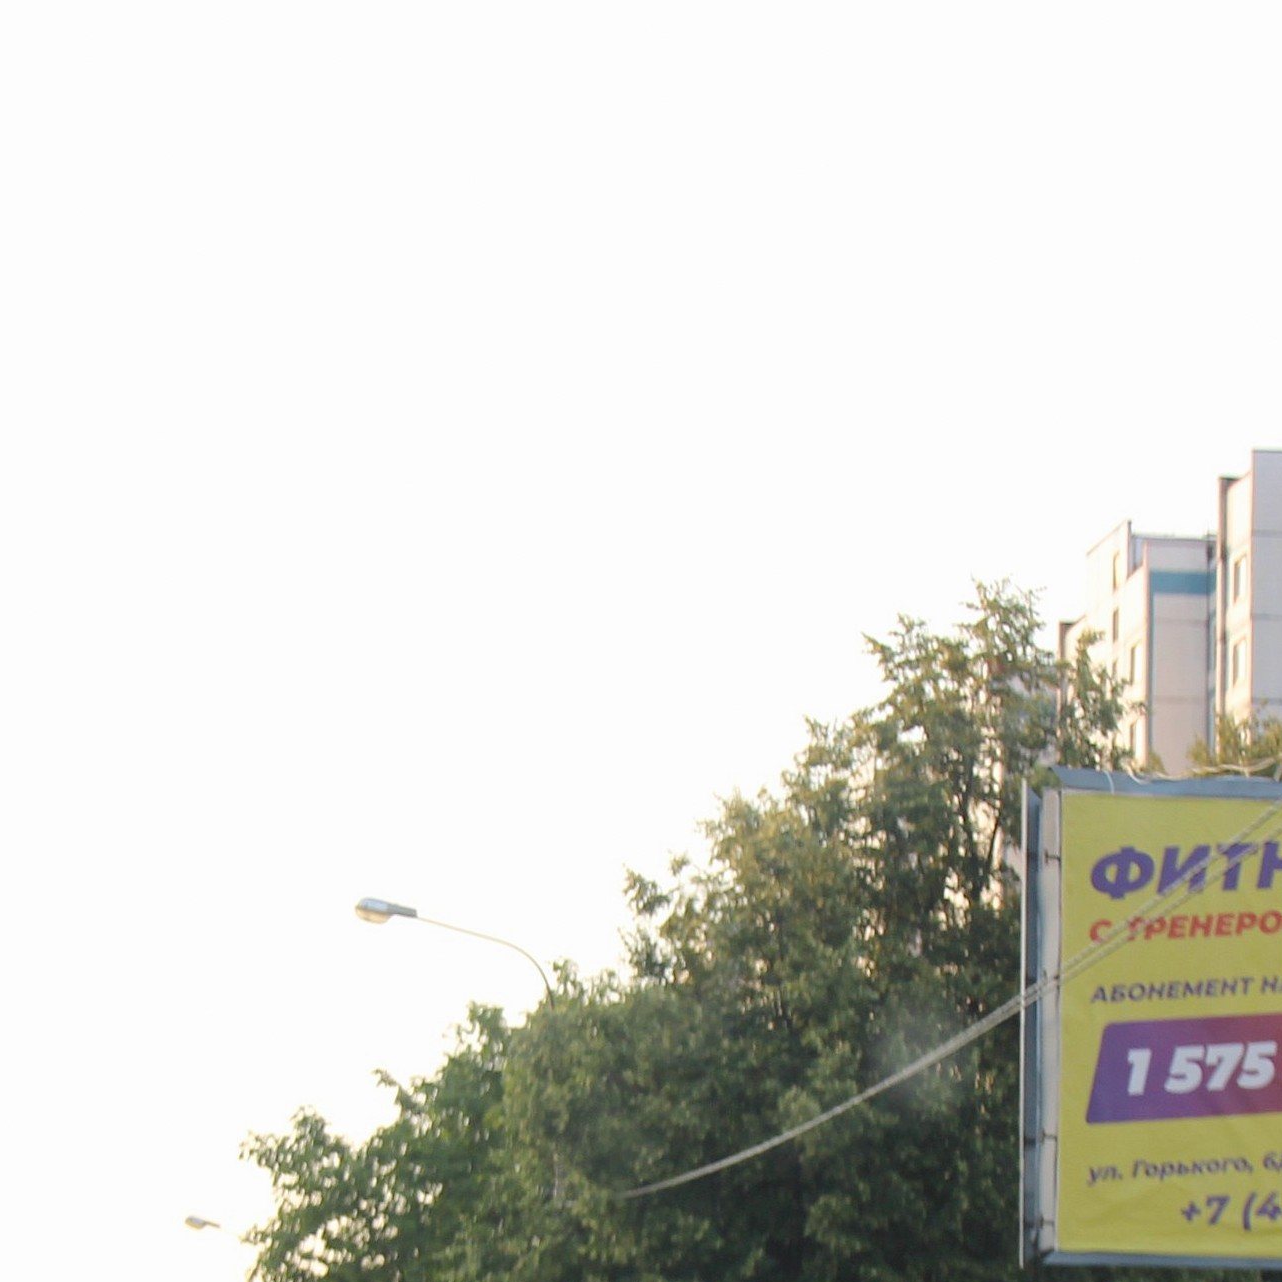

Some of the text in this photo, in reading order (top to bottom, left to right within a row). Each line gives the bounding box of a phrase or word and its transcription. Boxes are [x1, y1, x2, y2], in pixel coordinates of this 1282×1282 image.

[1090, 919, 1112, 945] С
[1091, 977, 1253, 1003] АБОНЕМЕНТ
[1127, 1048, 1152, 1096] 1
[1164, 1042, 1277, 1094] 575
[1087, 1164, 1123, 1187] ул.
[1131, 1152, 1253, 1180] Горького,
[1180, 1195, 1230, 1225] +7
